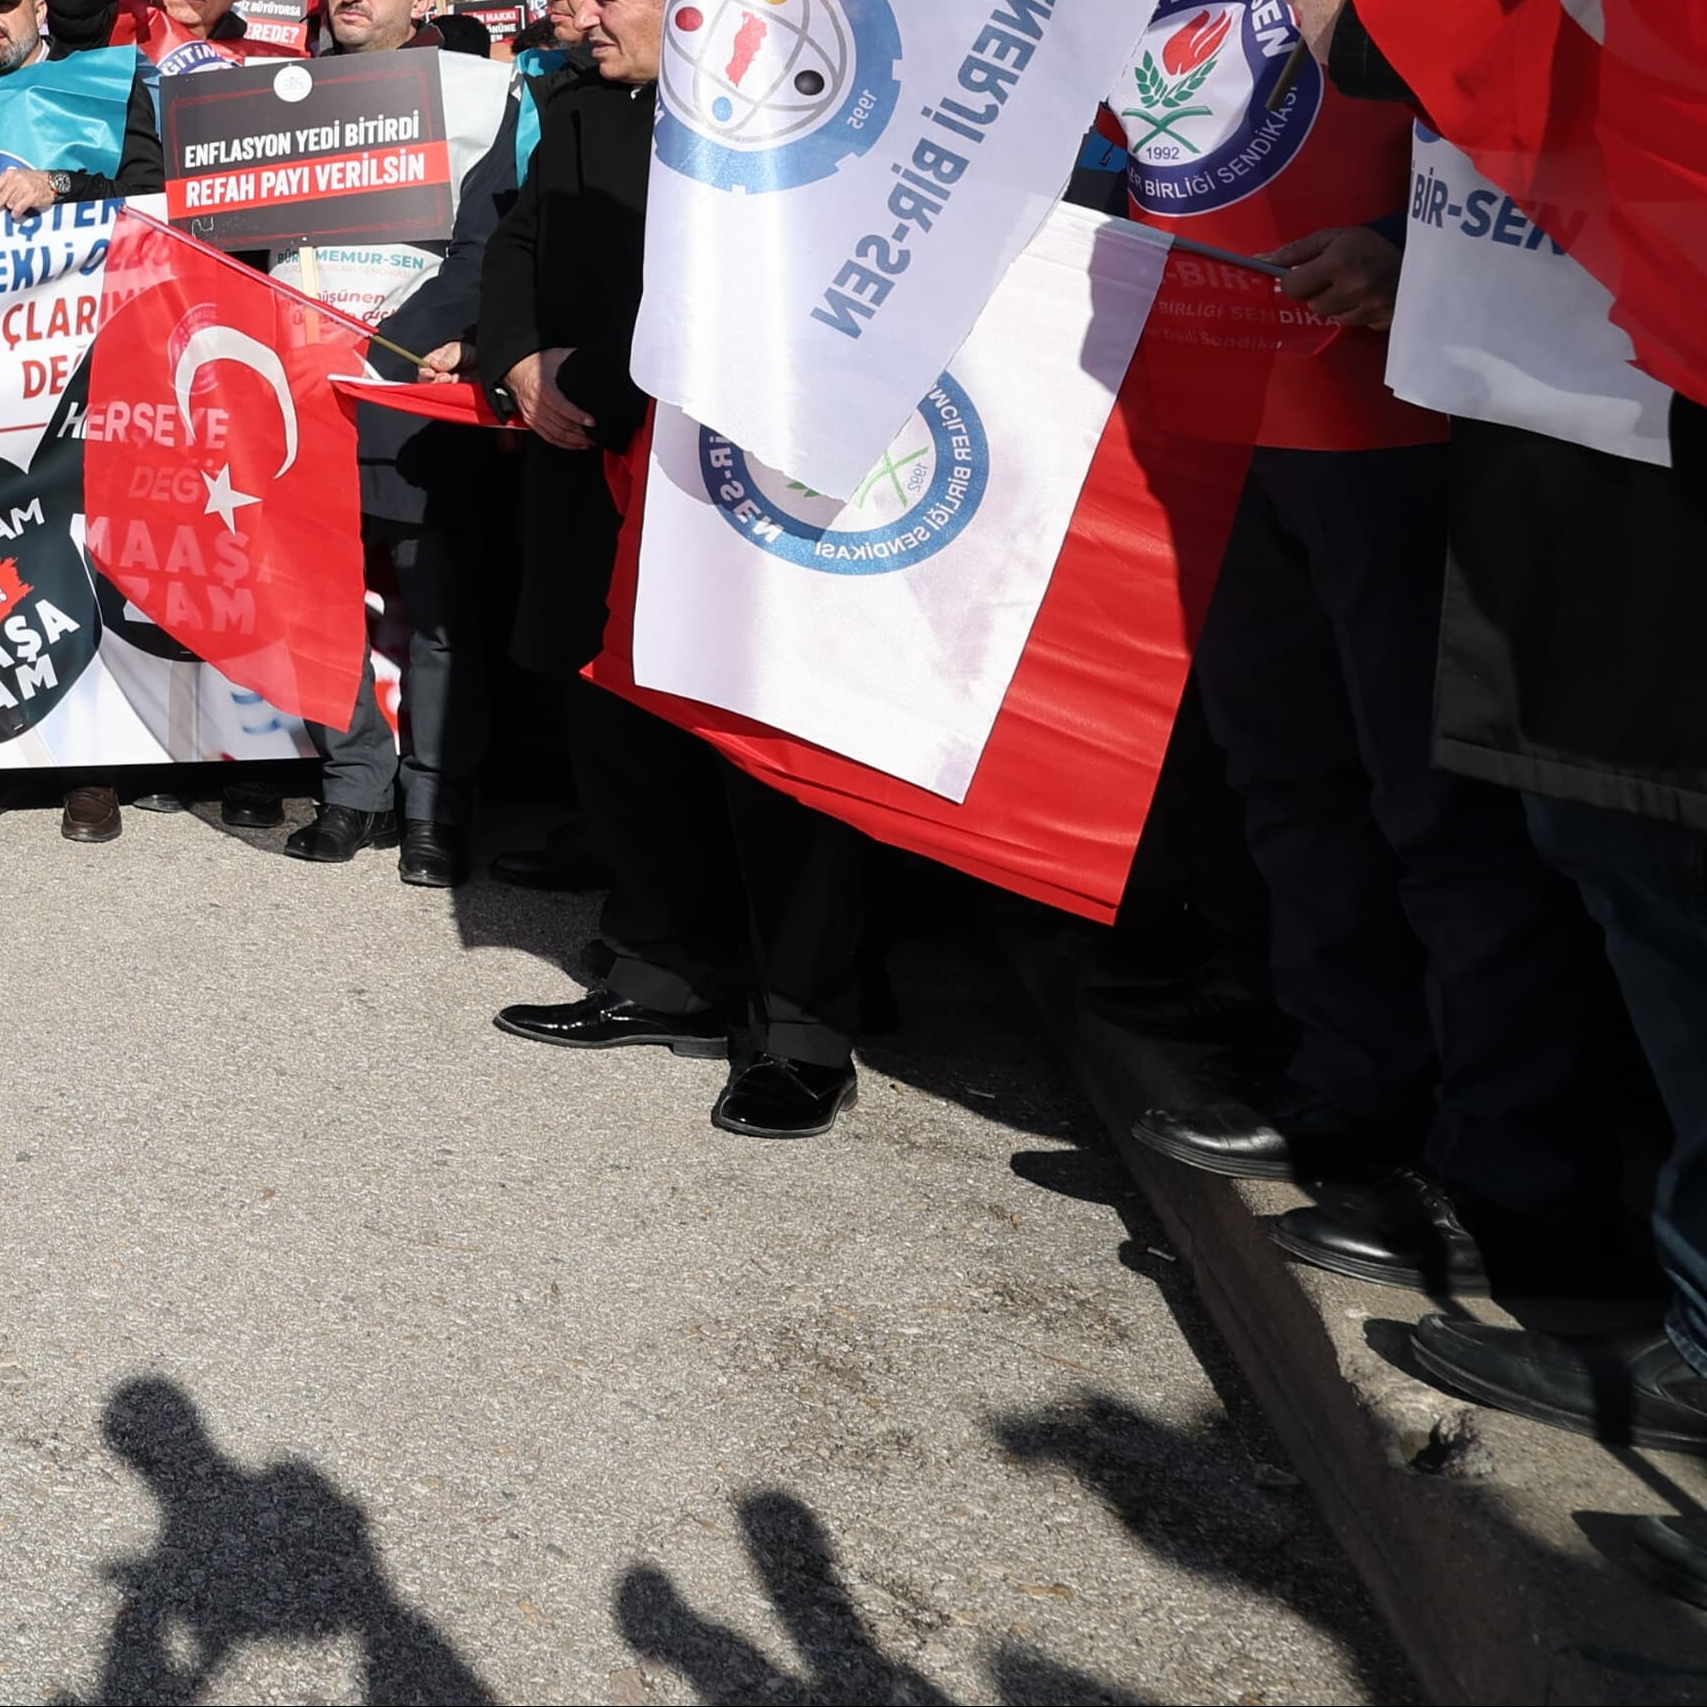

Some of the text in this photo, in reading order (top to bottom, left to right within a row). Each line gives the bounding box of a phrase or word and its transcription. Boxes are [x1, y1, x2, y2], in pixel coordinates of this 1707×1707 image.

[185, 110, 419, 169] ENFLASYON YEDİ BİTİRDİ
[1146, 146, 1179, 160] 1992
[185, 148, 425, 208] REFAH PAYI VERİLSİN
[1145, 171, 1215, 198] BİRLİĞİ
[315, 250, 424, 270] MEMUR-SEN
